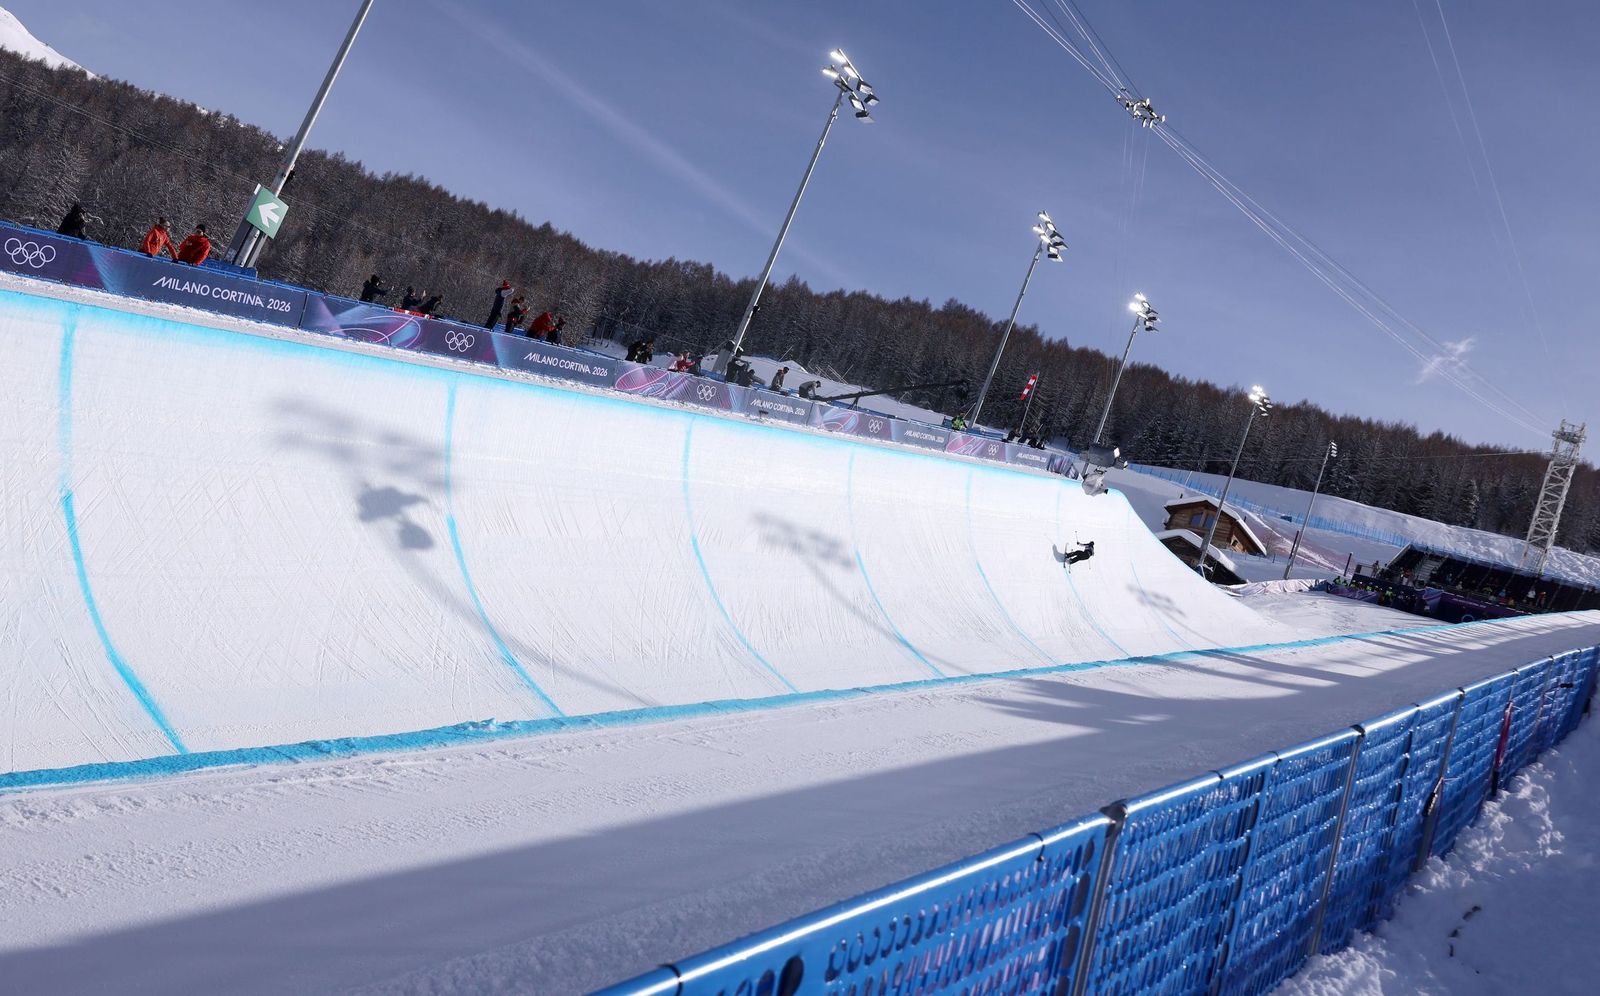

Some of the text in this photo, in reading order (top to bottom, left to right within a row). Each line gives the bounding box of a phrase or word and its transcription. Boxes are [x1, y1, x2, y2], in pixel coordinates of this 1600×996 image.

[152, 276, 292, 312] MILANO CORTINA 2026
[523, 352, 608, 377] MILANO CORTINA 2026
